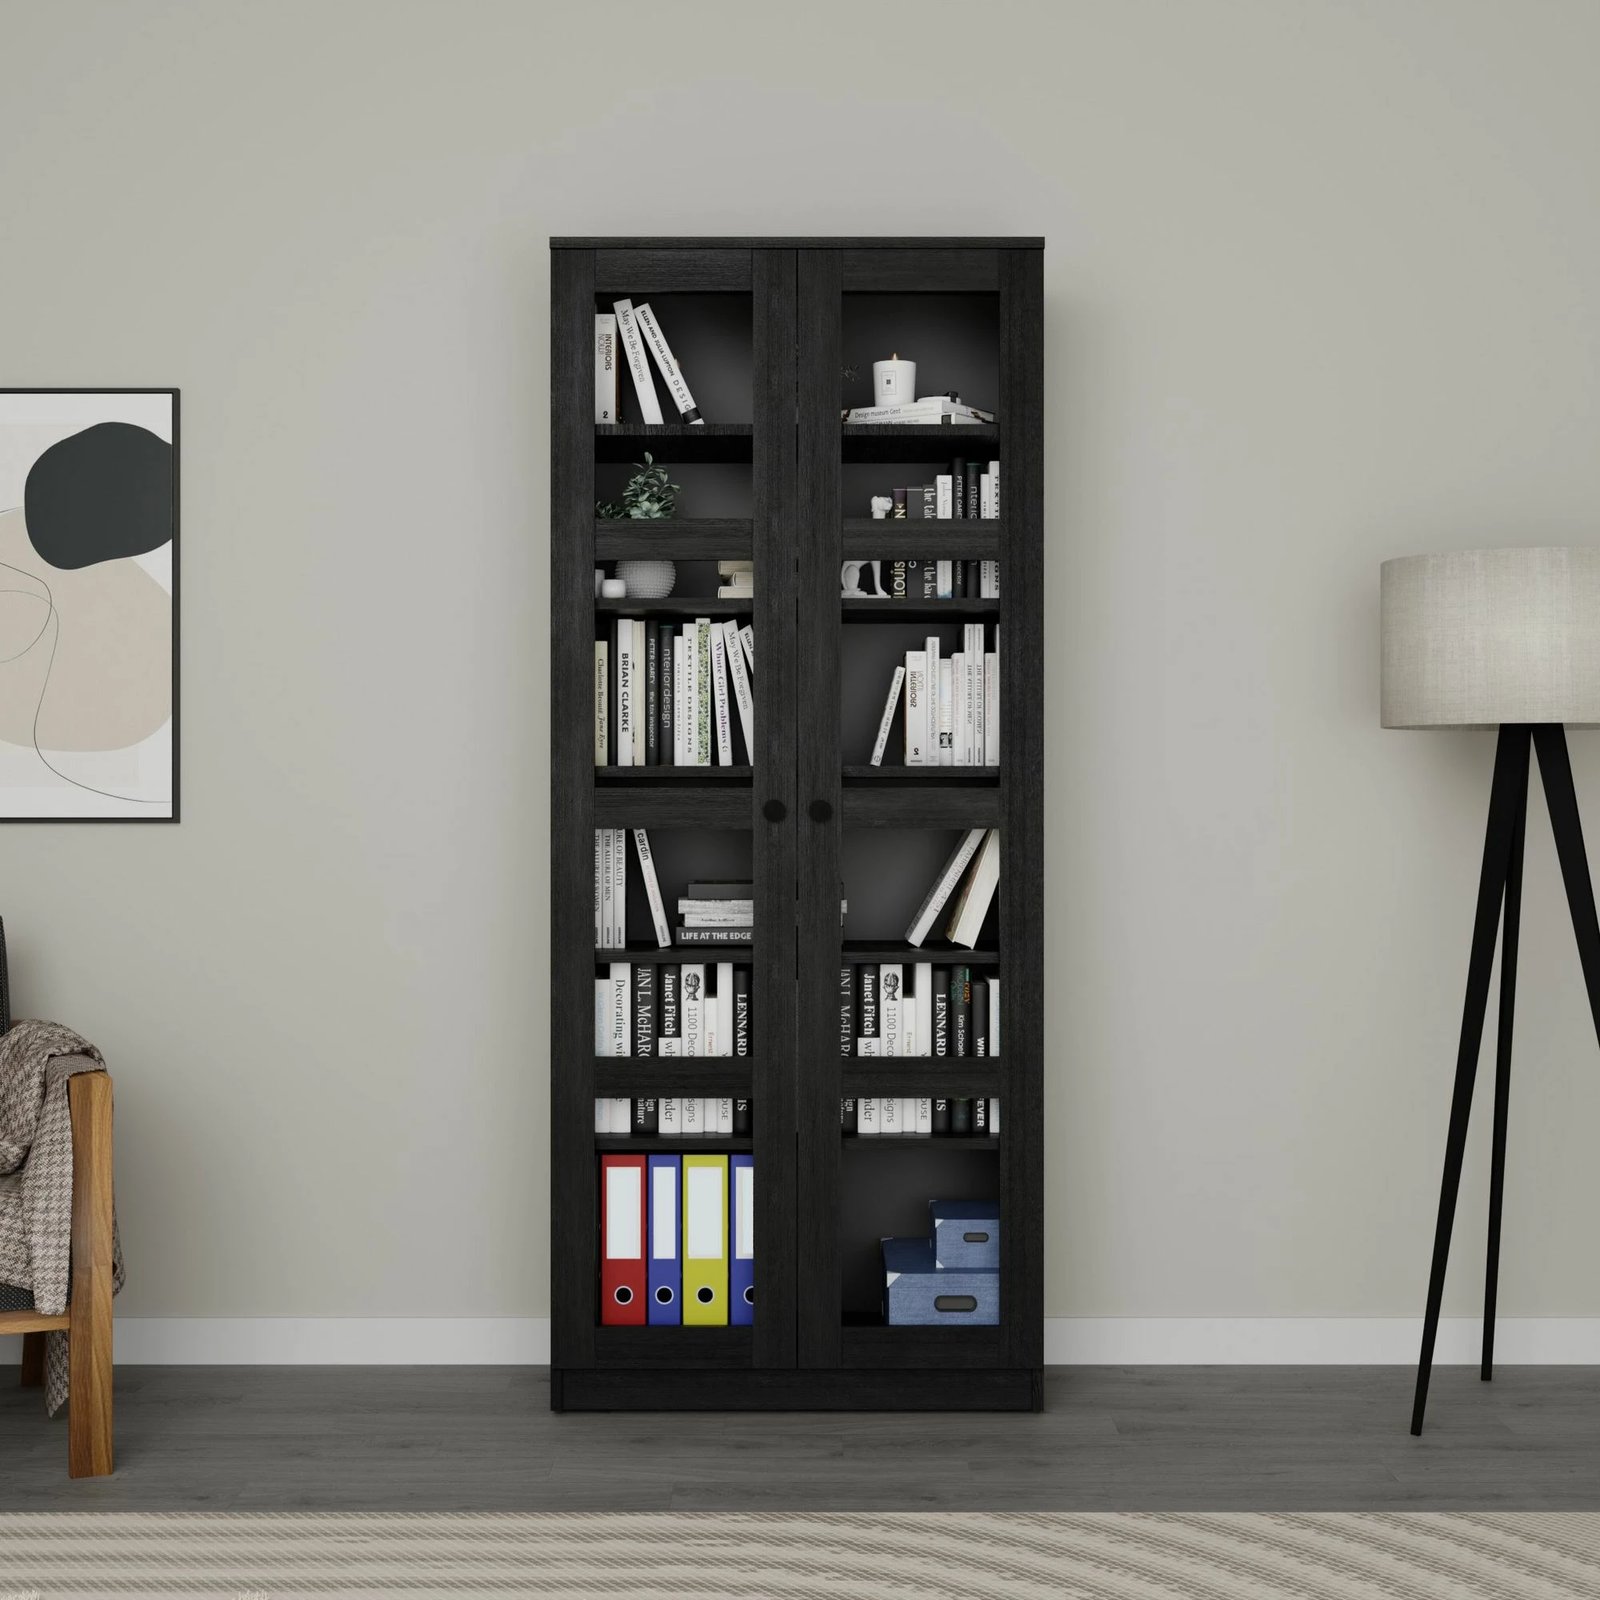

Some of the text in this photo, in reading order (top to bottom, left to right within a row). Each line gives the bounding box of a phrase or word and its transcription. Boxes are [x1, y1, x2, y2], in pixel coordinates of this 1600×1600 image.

[620, 309, 645, 383] May We Be Forgiven
[641, 310, 652, 326] ELLEN
[648, 326, 657, 339] AND
[654, 338, 664, 355] JULIA
[661, 353, 676, 377] LUPTON
[602, 410, 608, 419] 2
[728, 632, 749, 710] May We Be Forgiven
[718, 698, 728, 744] Problems
[637, 832, 650, 861] cardin
[613, 979, 625, 1039] Decorating
[664, 973, 676, 1035] Janet Fitch
[687, 1007, 697, 1030] 1100
[737, 993, 747, 1056] LENNARD
[864, 973, 875, 1035] Janet Fitch
[887, 1007, 896, 1030] 1100
[936, 993, 946, 1056] LENNARD
